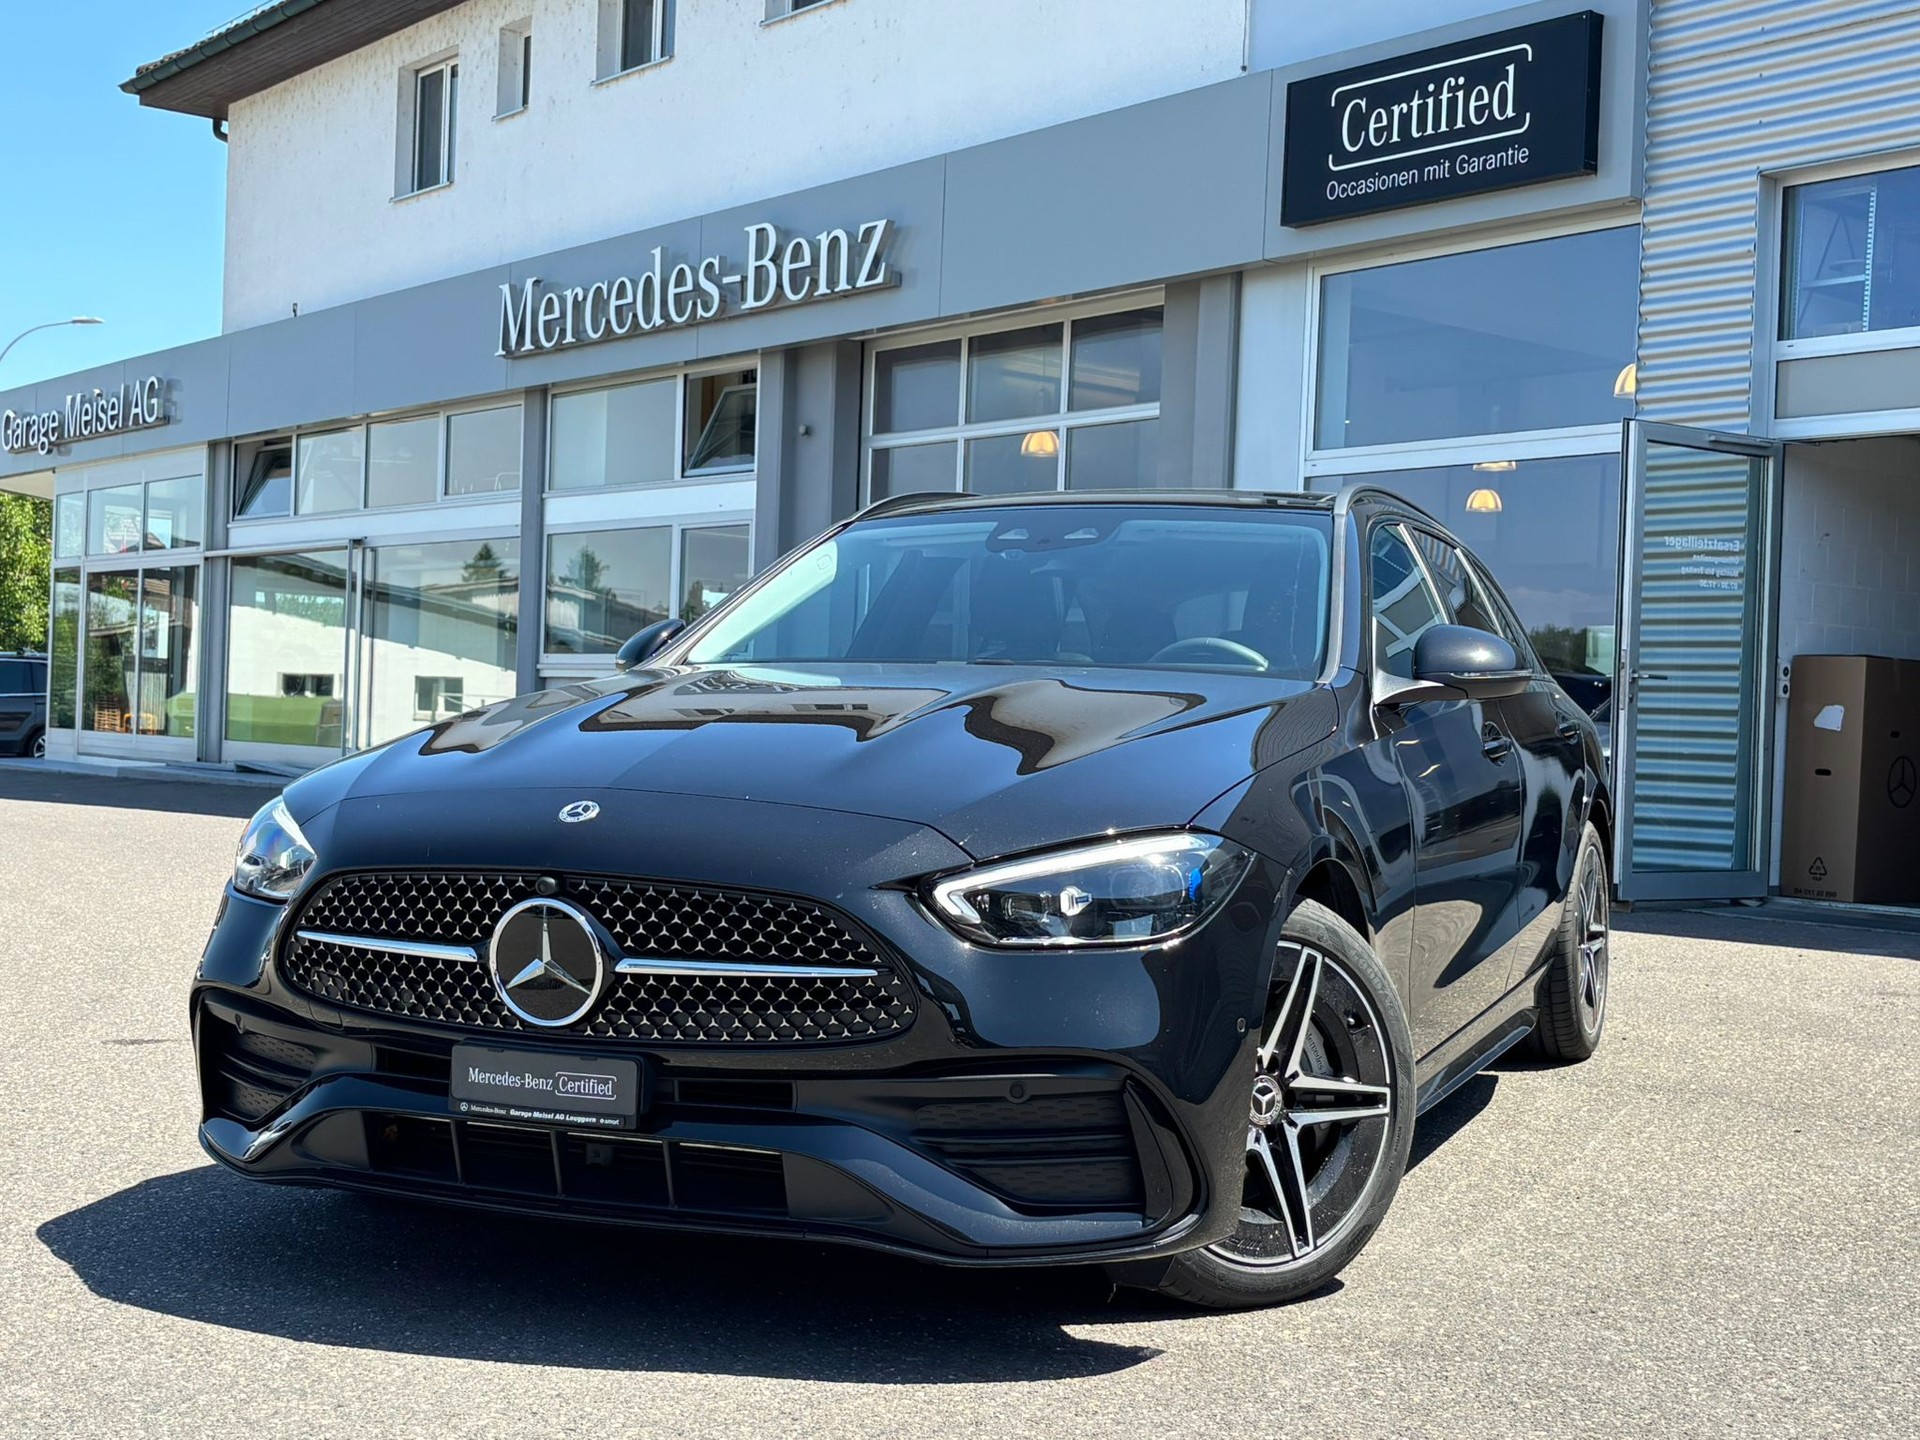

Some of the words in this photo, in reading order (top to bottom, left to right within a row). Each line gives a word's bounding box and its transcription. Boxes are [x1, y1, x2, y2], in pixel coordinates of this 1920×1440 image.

[1341, 63, 1516, 152] Certified
[1326, 169, 1418, 200] Occasionen
[1424, 159, 1450, 182] mit
[1456, 144, 1529, 175] Garantie
[494, 218, 890, 357] Mercedes-Benz
[1, 409, 59, 455] Garage
[64, 383, 125, 438] Meisel
[129, 375, 159, 426] AG
[468, 1067, 553, 1090] Mercedes-Benz
[558, 1076, 613, 1096] Certified
[510, 1108, 532, 1118] Garage
[533, 1111, 554, 1119] Meisel
